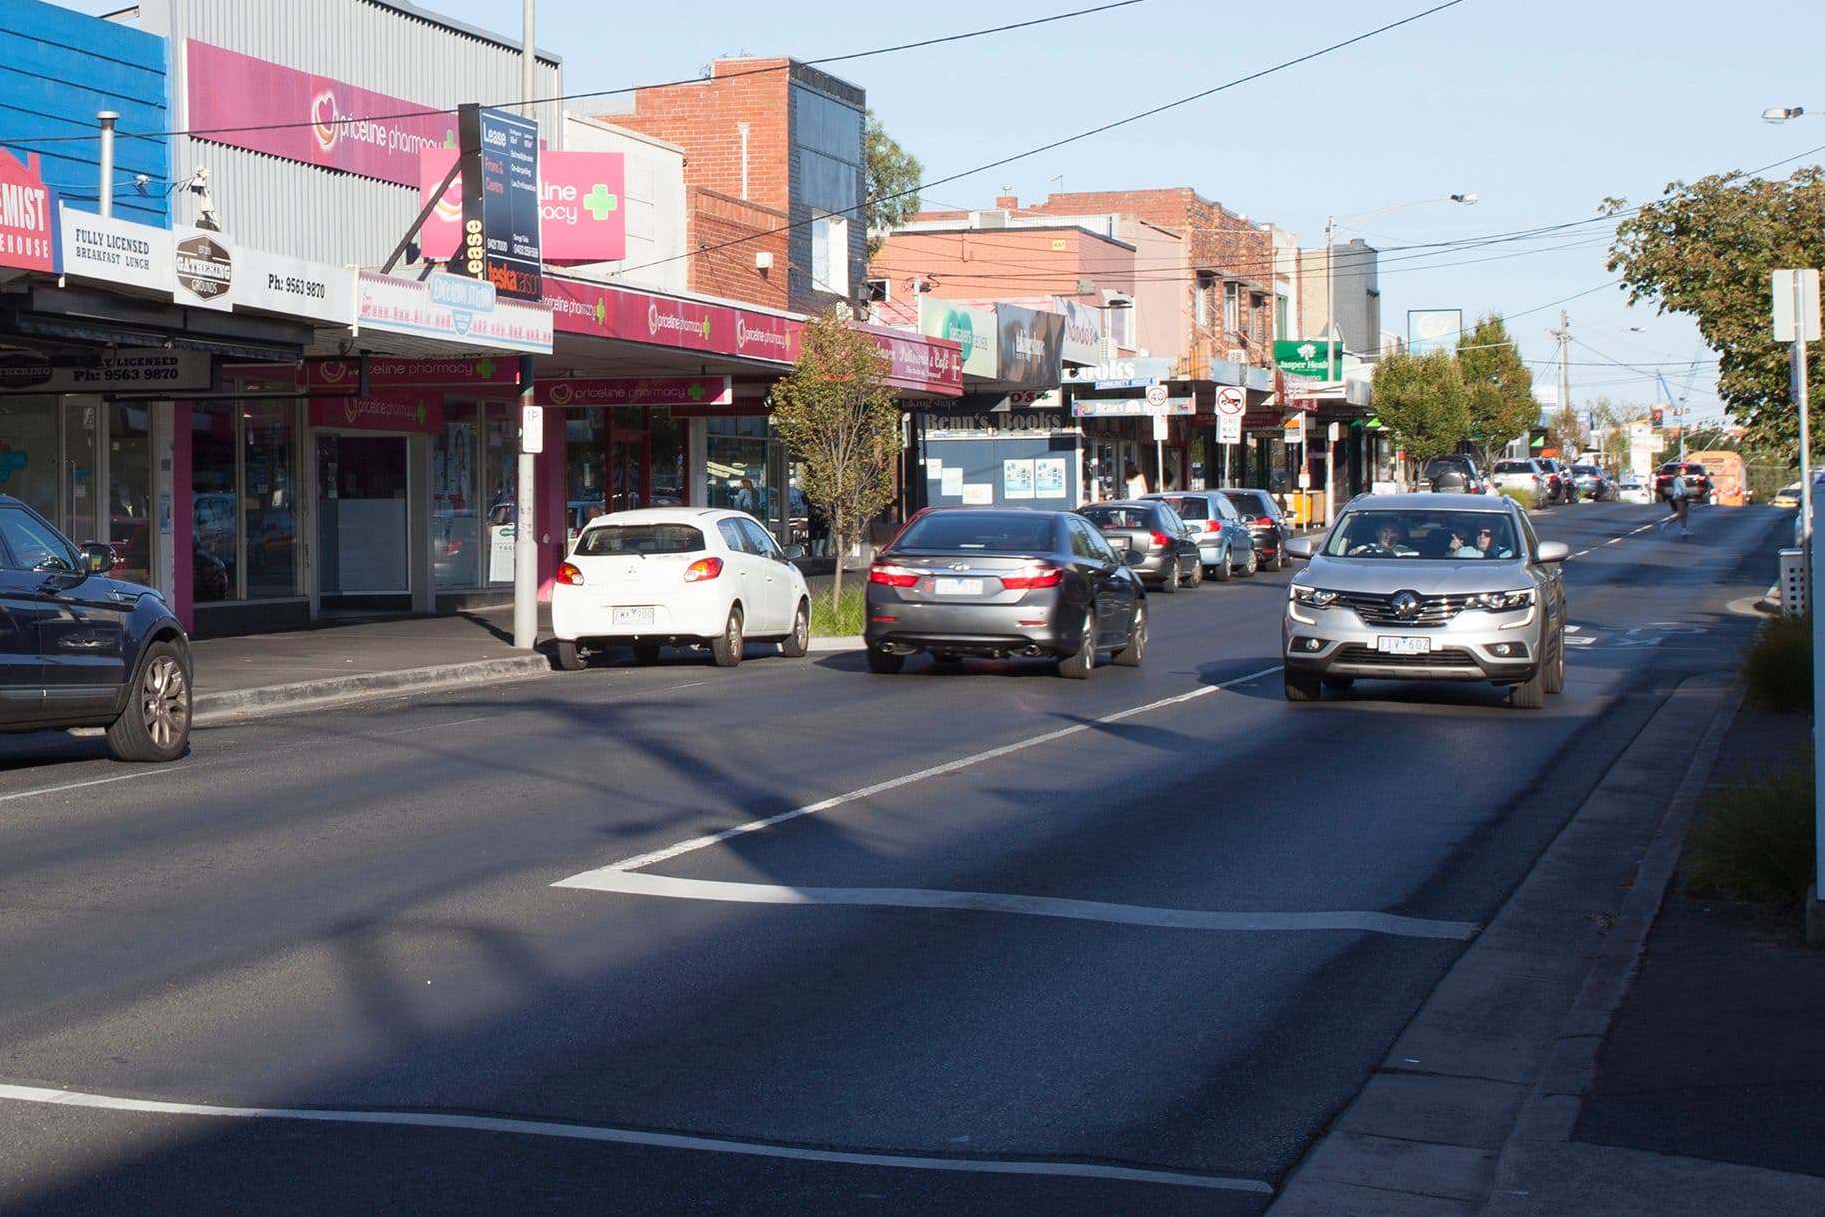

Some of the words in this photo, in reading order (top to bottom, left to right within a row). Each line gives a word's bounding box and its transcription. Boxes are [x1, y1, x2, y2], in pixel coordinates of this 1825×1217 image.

[340, 112, 387, 147] priceline
[483, 121, 507, 147] Lease
[75, 228, 105, 248] FULLY
[106, 233, 150, 256] LICENSED
[76, 246, 121, 265] BREAKFAST
[125, 254, 150, 271] LUNCH
[268, 273, 284, 293] Ph:
[285, 277, 305, 295] 9563
[305, 280, 326, 300] 9870
[115, 356, 178, 367] LICENSED
[408, 362, 473, 376] pharmacy
[73, 368, 101, 382] Ph:
[104, 368, 142, 382] 9563
[143, 367, 179, 380] 9870
[574, 387, 626, 400] priceline
[628, 386, 686, 400] pharmacy
[1150, 391, 1164, 402] 40
[926, 413, 989, 430] Benn's
[998, 411, 1062, 430] Books
